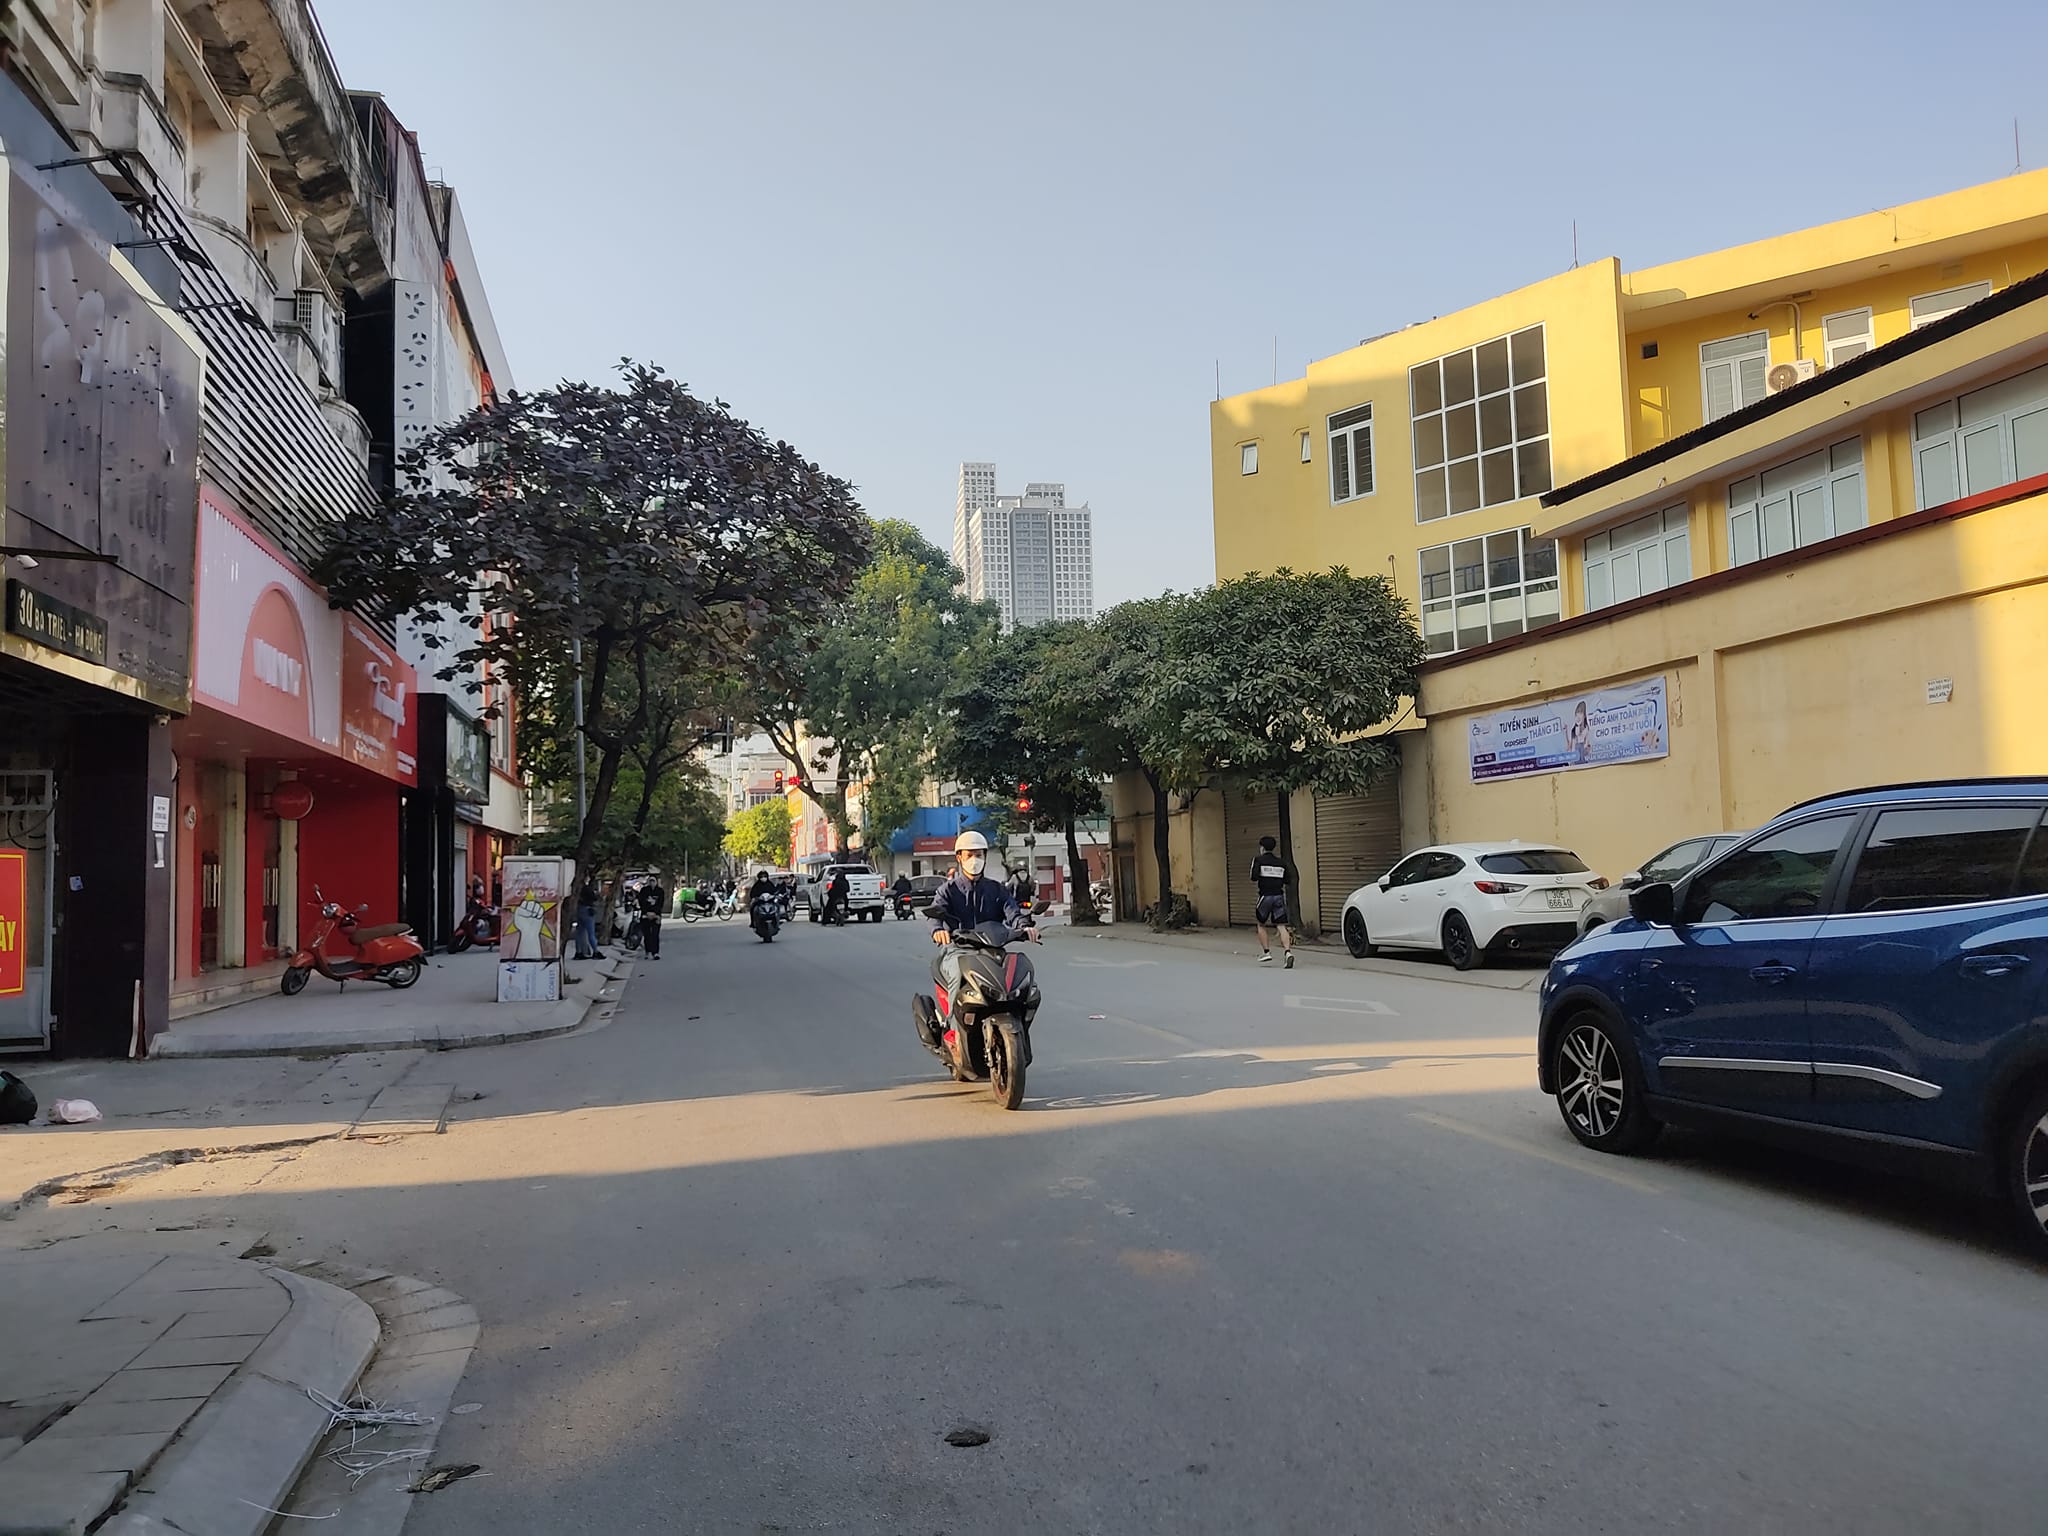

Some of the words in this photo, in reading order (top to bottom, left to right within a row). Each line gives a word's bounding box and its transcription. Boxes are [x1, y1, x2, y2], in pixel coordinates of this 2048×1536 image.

[20, 588, 34, 629] 30
[1523, 716, 1539, 729] SINH
[1606, 713, 1619, 723] ANH
[1553, 722, 1559, 733] 12
[1595, 729, 1610, 738] CHO
